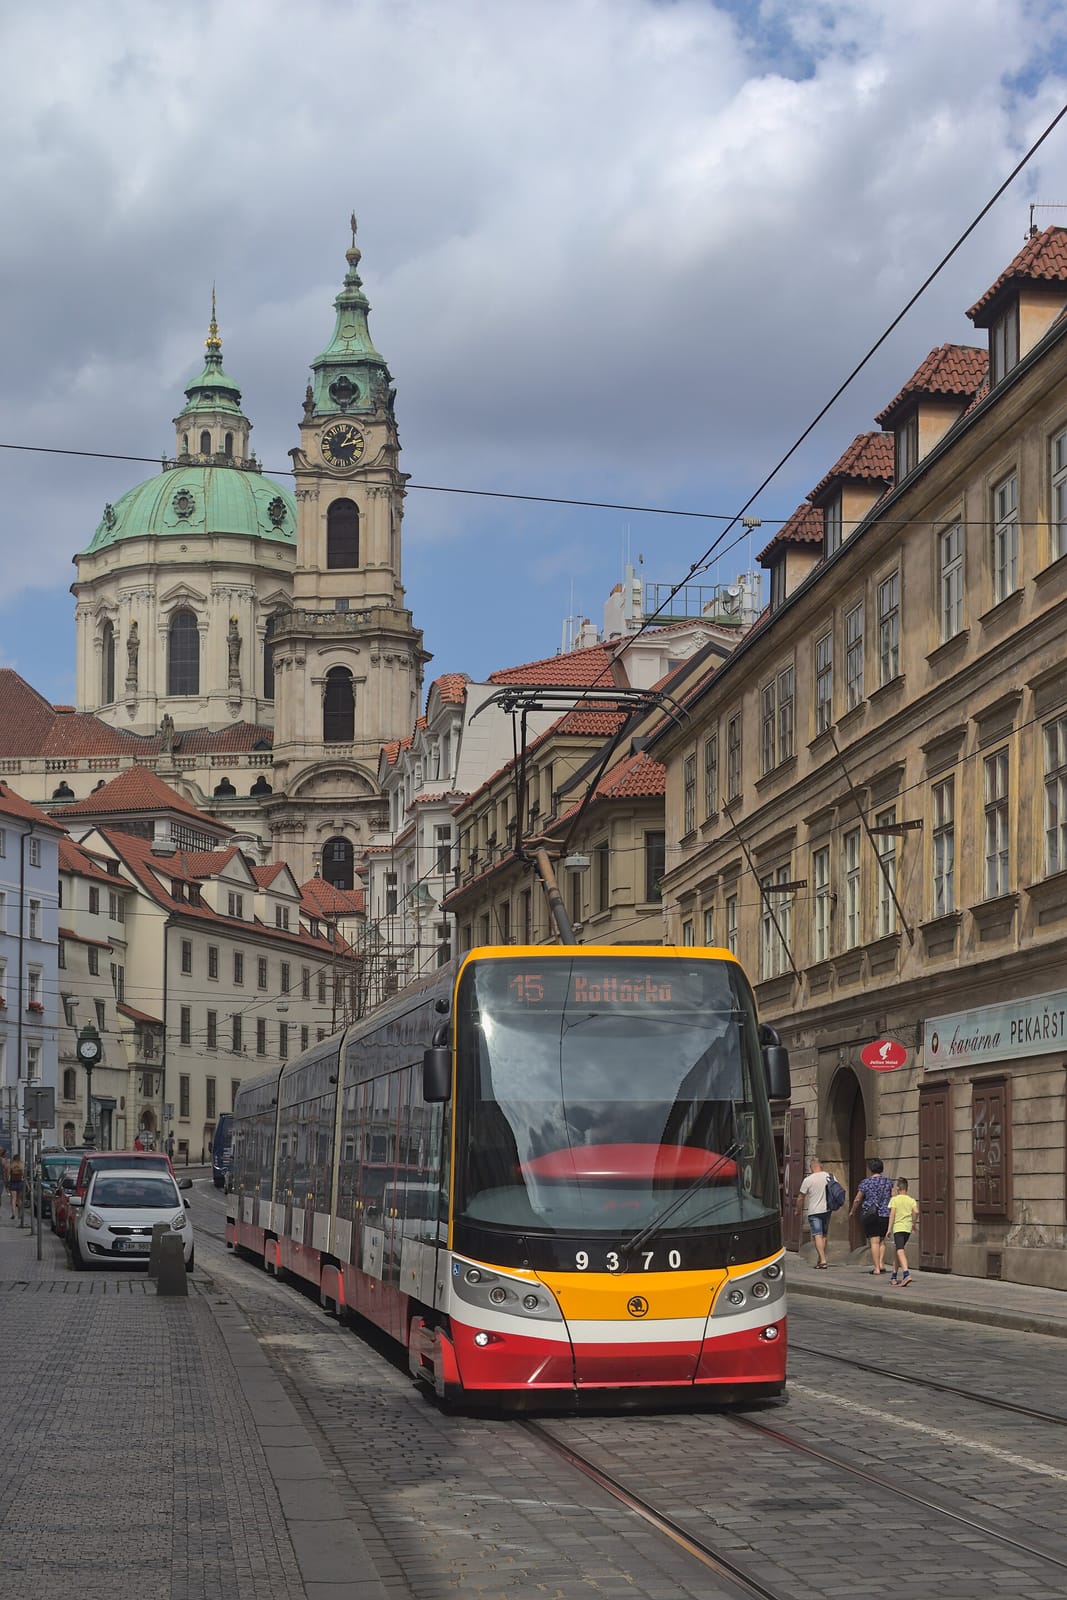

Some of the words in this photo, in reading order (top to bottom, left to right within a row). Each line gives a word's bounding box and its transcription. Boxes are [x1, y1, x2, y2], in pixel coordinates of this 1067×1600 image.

[510, 974, 544, 1002] 15
[948, 1025, 1001, 1055] kavárna
[1010, 1006, 1065, 1045] PEKAŘST
